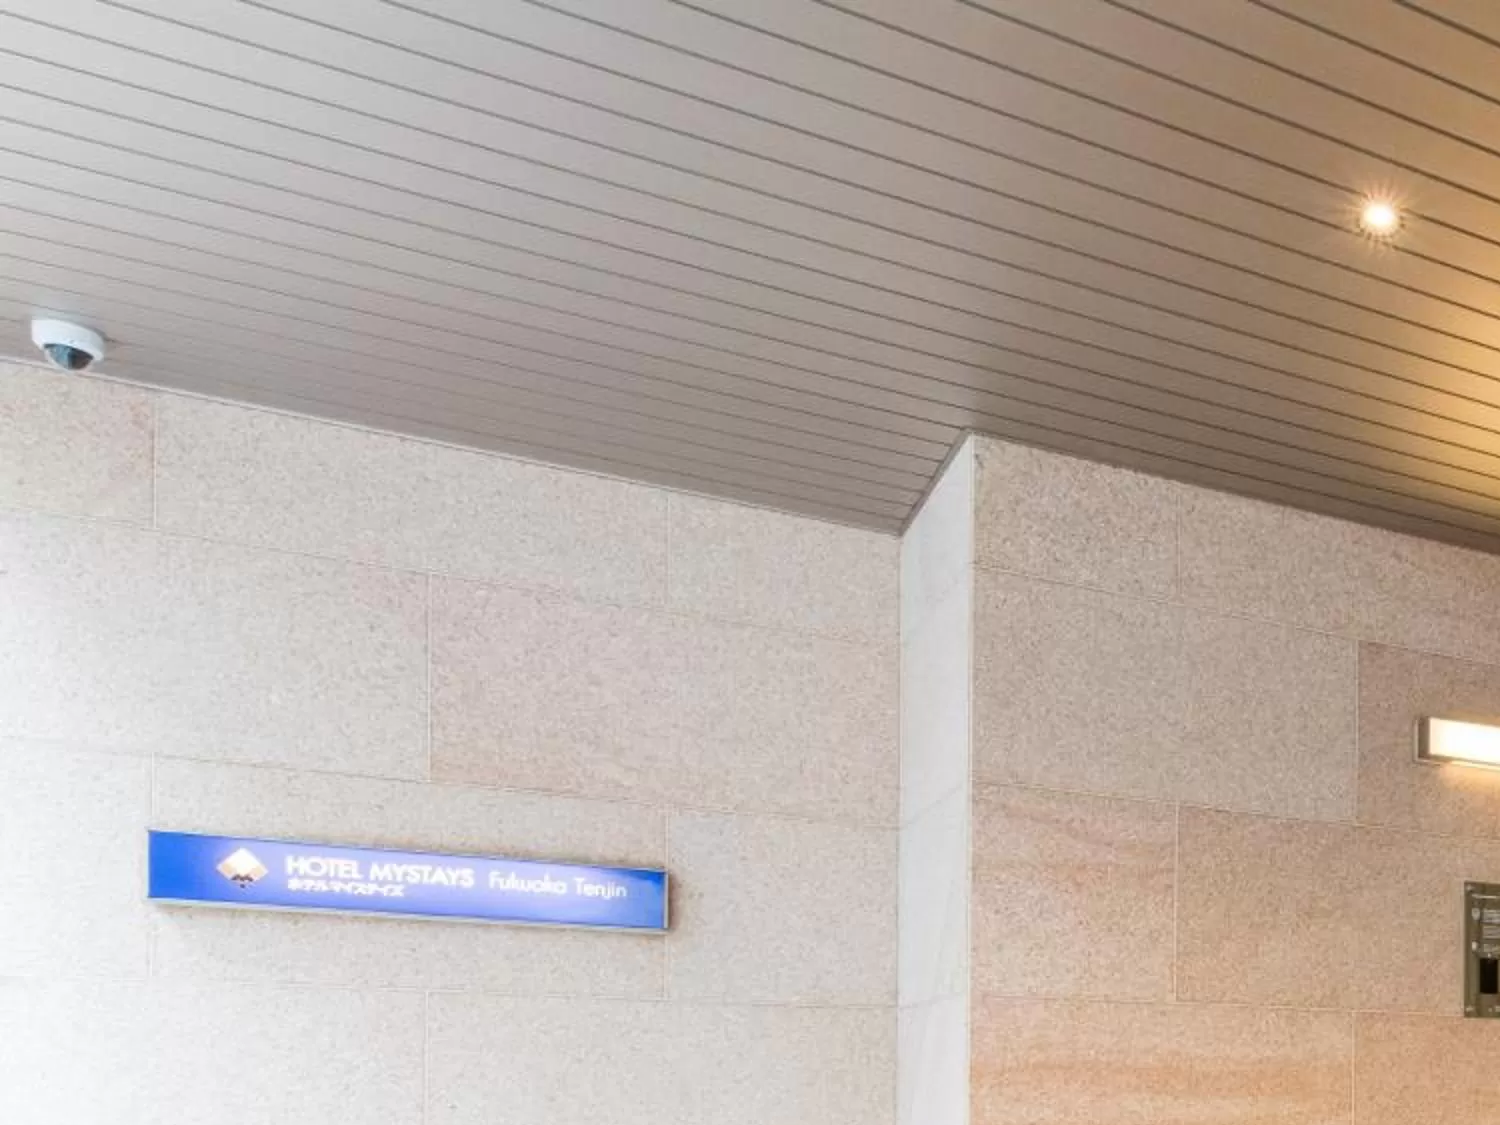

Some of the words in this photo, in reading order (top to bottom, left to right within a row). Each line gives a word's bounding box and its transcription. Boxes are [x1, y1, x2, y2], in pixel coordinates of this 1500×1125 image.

[286, 856, 363, 879] HOTEL
[371, 862, 475, 888] MYSTAYS
[489, 871, 567, 894] Fukuoka
[575, 876, 628, 900] Tenjin
